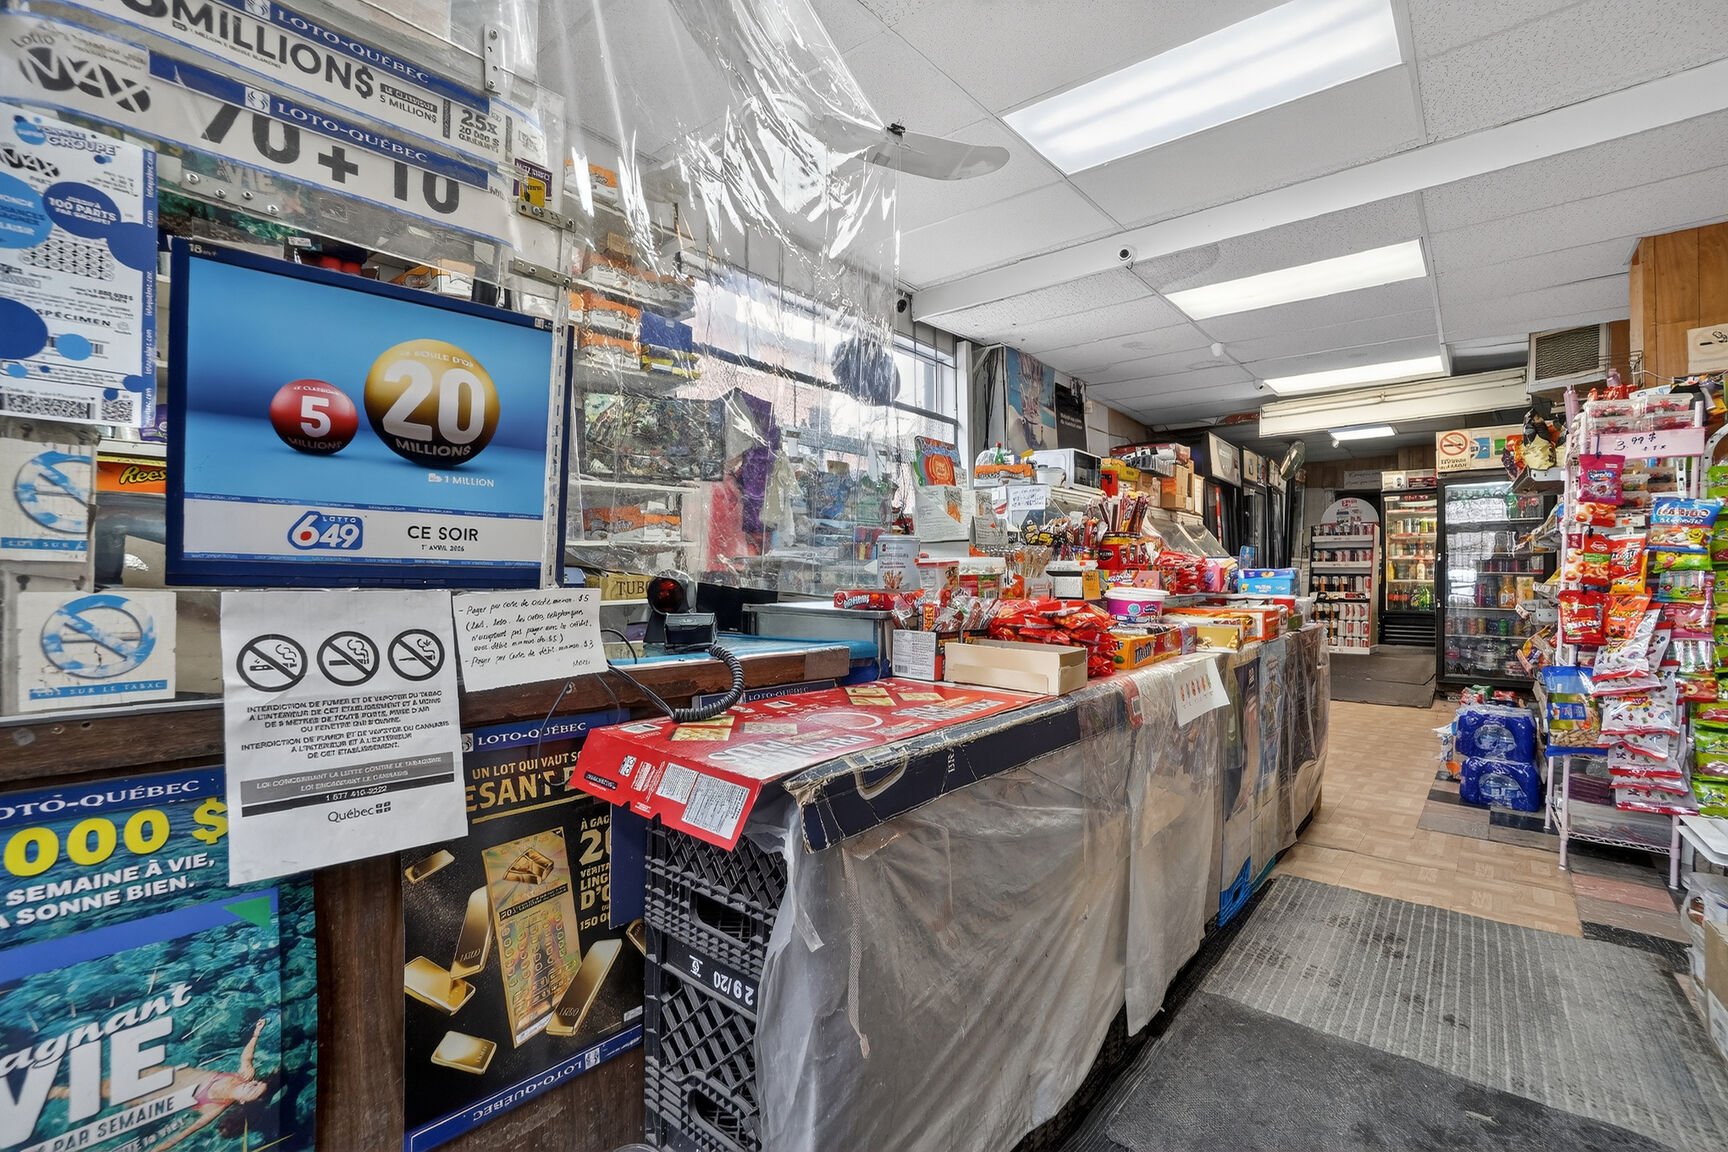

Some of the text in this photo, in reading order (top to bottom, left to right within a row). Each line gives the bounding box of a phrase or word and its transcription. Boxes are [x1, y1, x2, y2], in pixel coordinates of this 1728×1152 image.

[277, 9, 430, 85] LOTO-QUÉBEC
[277, 102, 428, 164] LOTO-QUÉBEC
[47, 136, 117, 157] GROUPE
[48, 196, 73, 210] 100
[76, 204, 117, 222] PARTS
[382, 359, 486, 446] 20
[300, 395, 332, 438] 5
[395, 438, 472, 458] MILLIONS
[452, 475, 495, 489] MILLION
[407, 526, 479, 542] CE SOIR
[615, 580, 649, 596] TUB
[124, 680, 163, 691] TABAC
[247, 702, 307, 713] INTERDICTION
[409, 691, 418, 699] DU
[241, 738, 301, 751] INTERDICTION
[403, 724, 414, 732] DU
[307, 751, 319, 759] DE
[472, 766, 490, 780] UN
[493, 762, 517, 777] LOT
[518, 758, 538, 773] QUI
[540, 753, 570, 768] VAUT
[327, 806, 375, 823] Québec
[581, 818, 588, 831] À
[3, 797, 229, 878] 000 $
[6, 852, 216, 907] SEMAINE À VIE,
[15, 895, 121, 927] SONNE
[126, 876, 196, 903] BIEN.
[580, 915, 599, 931] 150
[97, 1096, 176, 1138] SEMAINE
